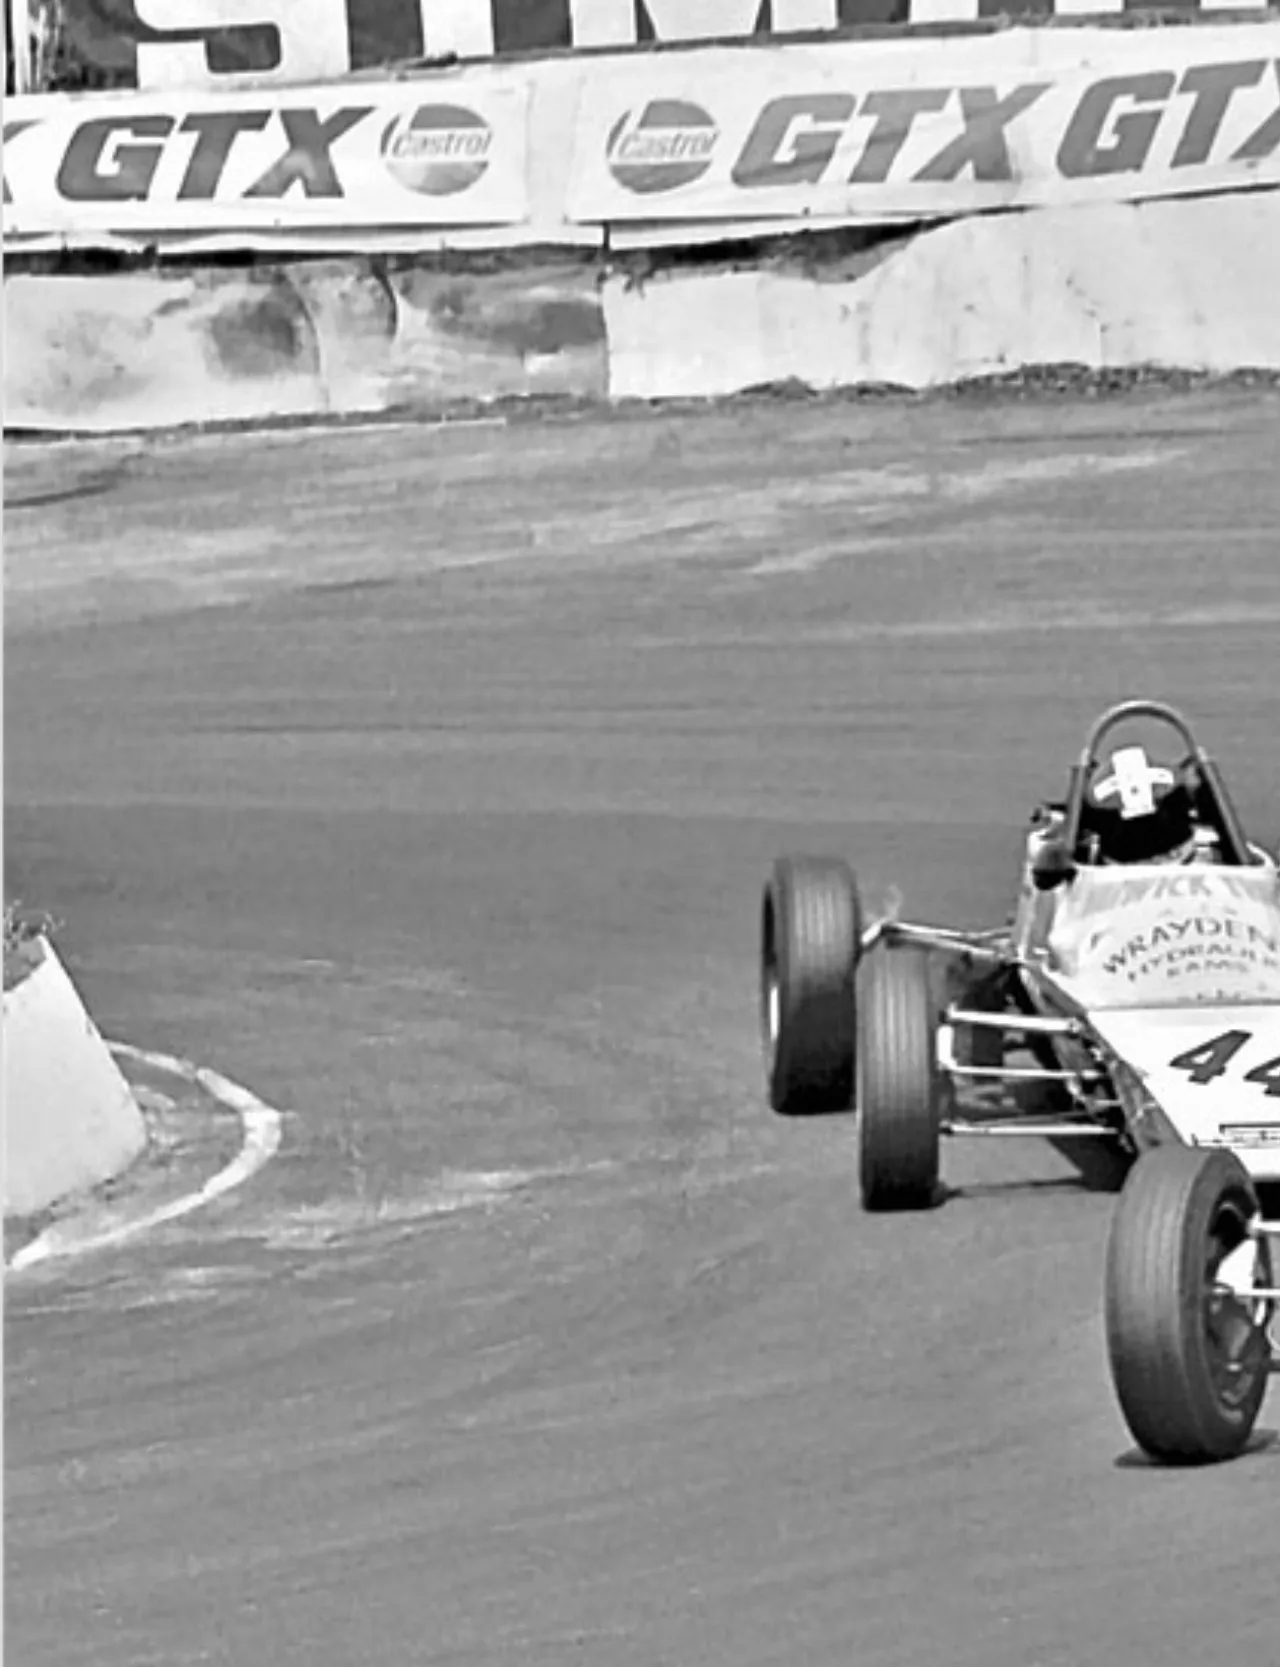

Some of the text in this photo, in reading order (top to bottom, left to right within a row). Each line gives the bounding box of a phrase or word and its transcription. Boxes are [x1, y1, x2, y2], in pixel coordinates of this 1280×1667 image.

[56, 106, 376, 202] GTX
[391, 131, 492, 157] Castrol
[618, 130, 720, 158] Castrol
[730, 82, 1054, 188] GTX
[1102, 917, 1279, 974] WRAYDEN
